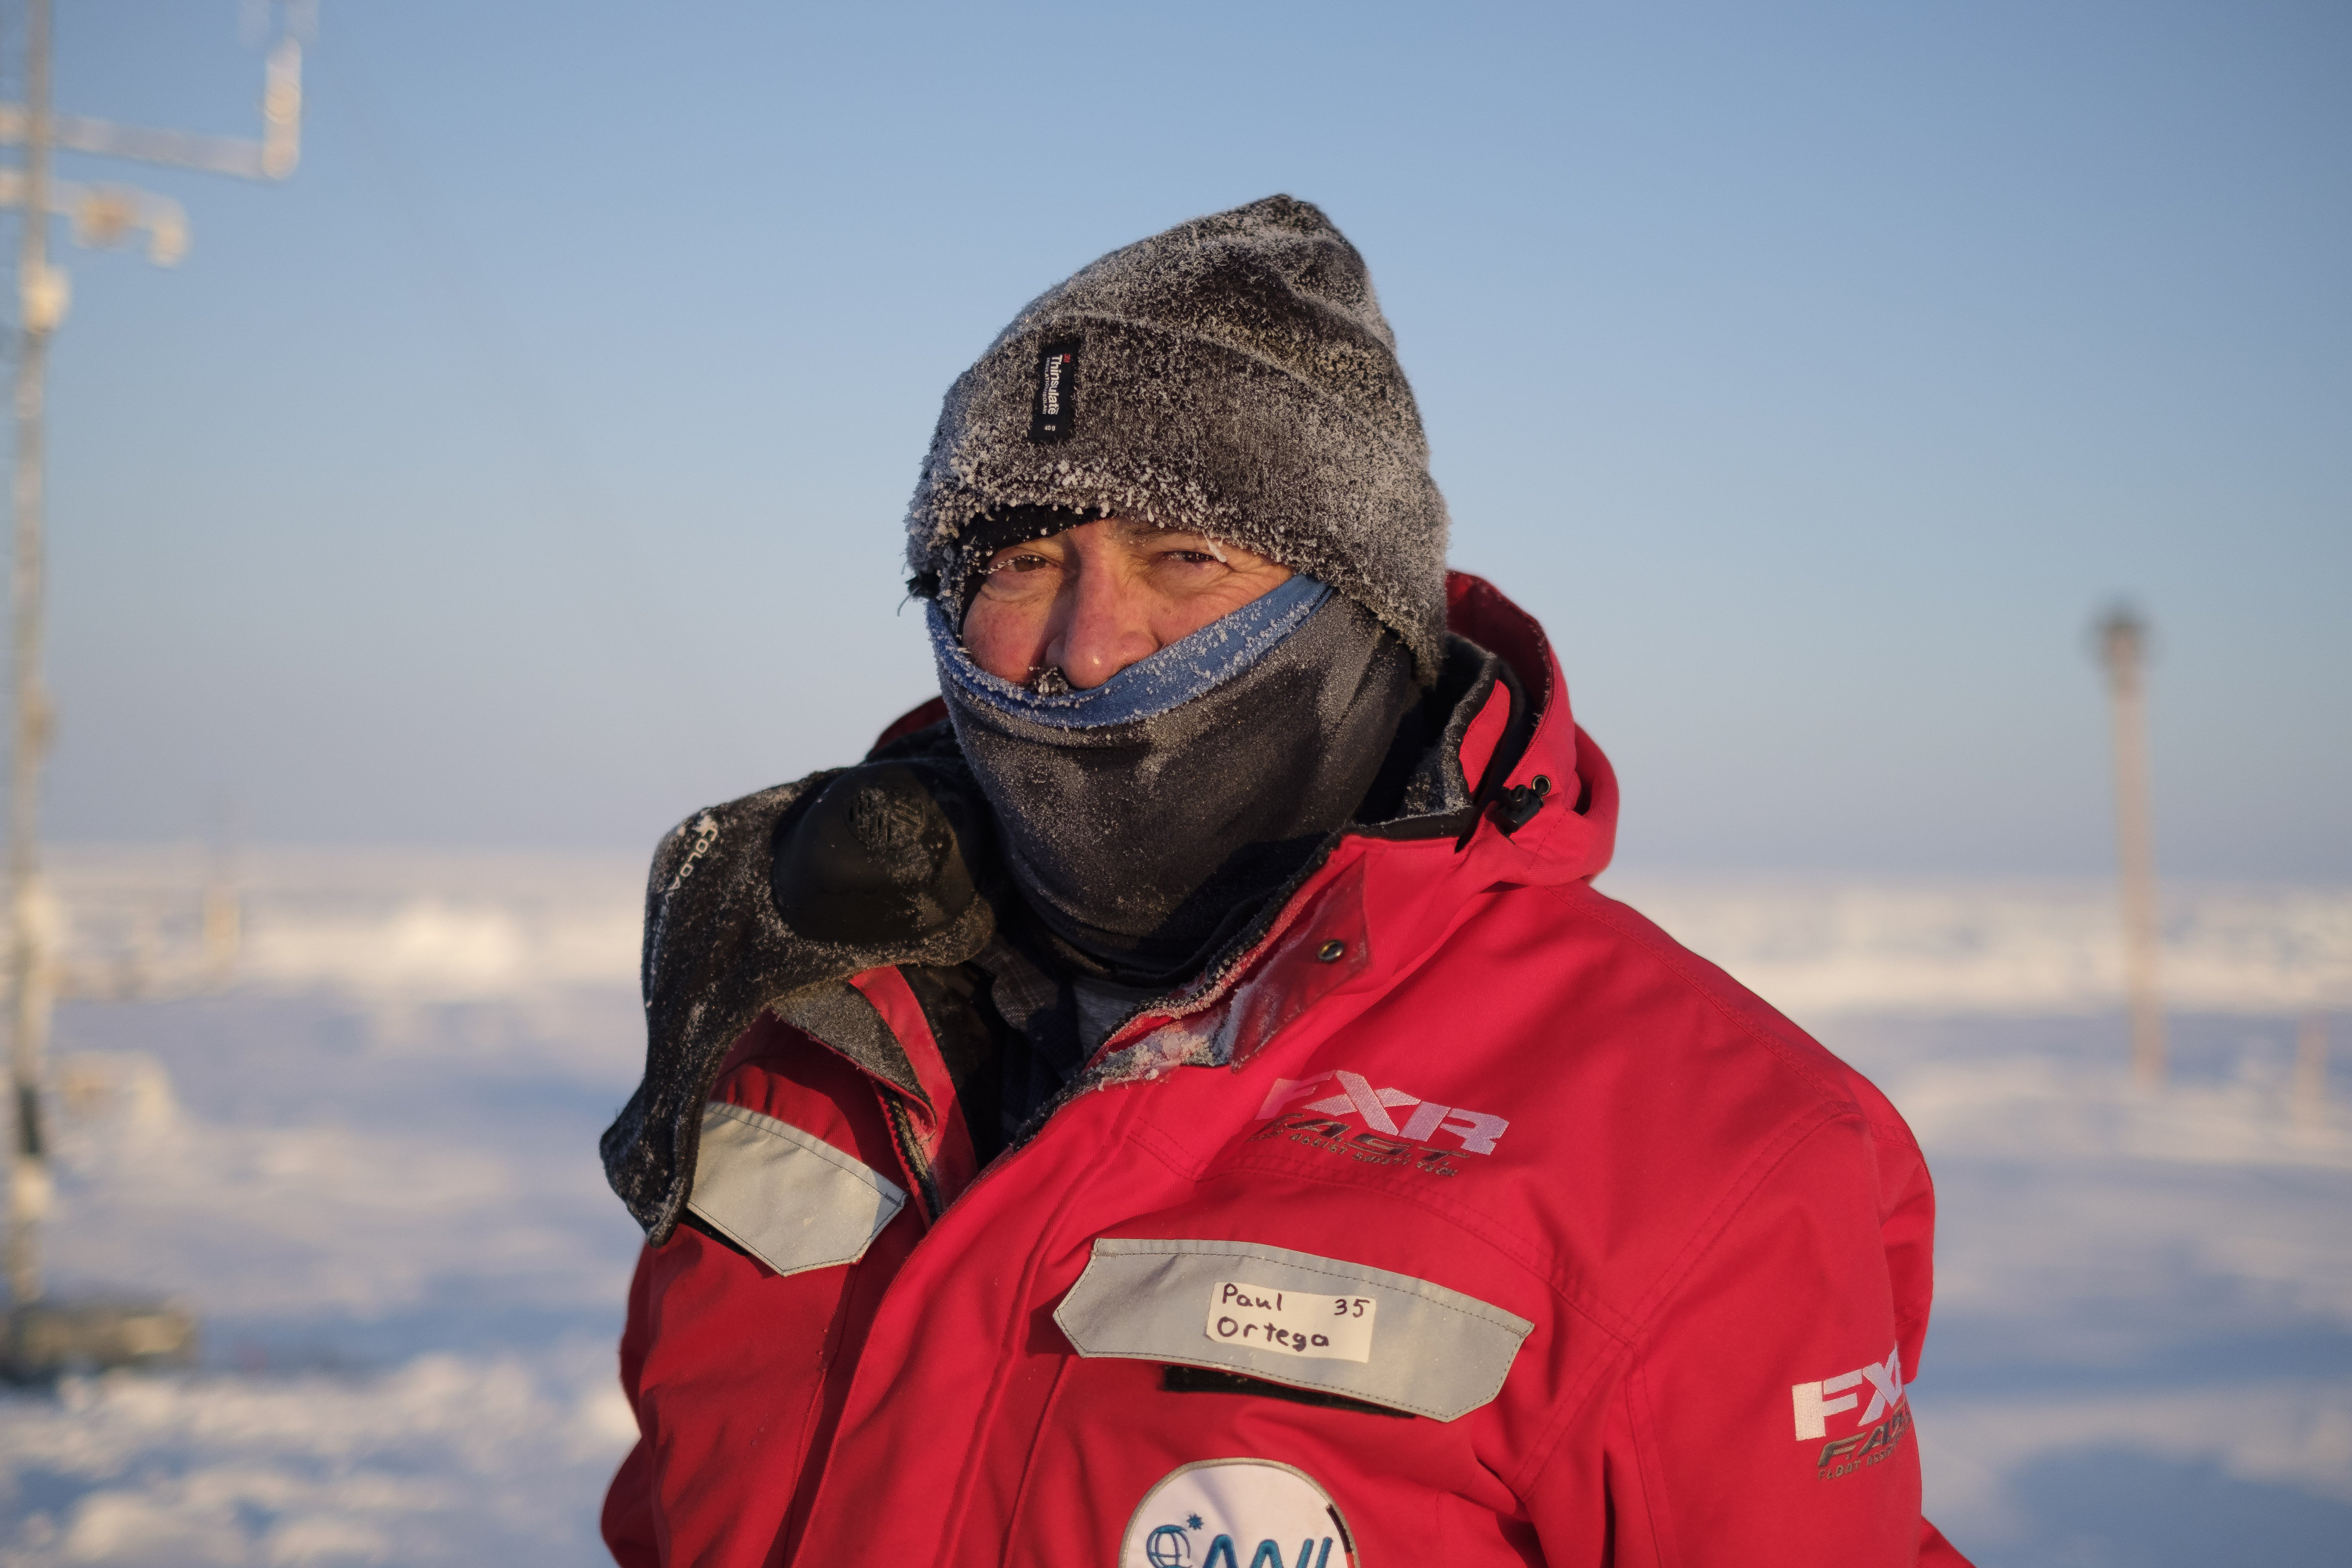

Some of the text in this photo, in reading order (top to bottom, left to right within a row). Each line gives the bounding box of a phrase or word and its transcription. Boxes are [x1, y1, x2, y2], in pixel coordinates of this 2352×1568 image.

[1063, 354, 1071, 363] 3M
[1048, 354, 1063, 415] Thinsulate
[1254, 1069, 1510, 1155] FXR
[1222, 1283, 1370, 1318] Paul 35
[1217, 1316, 1330, 1352] Ortega
